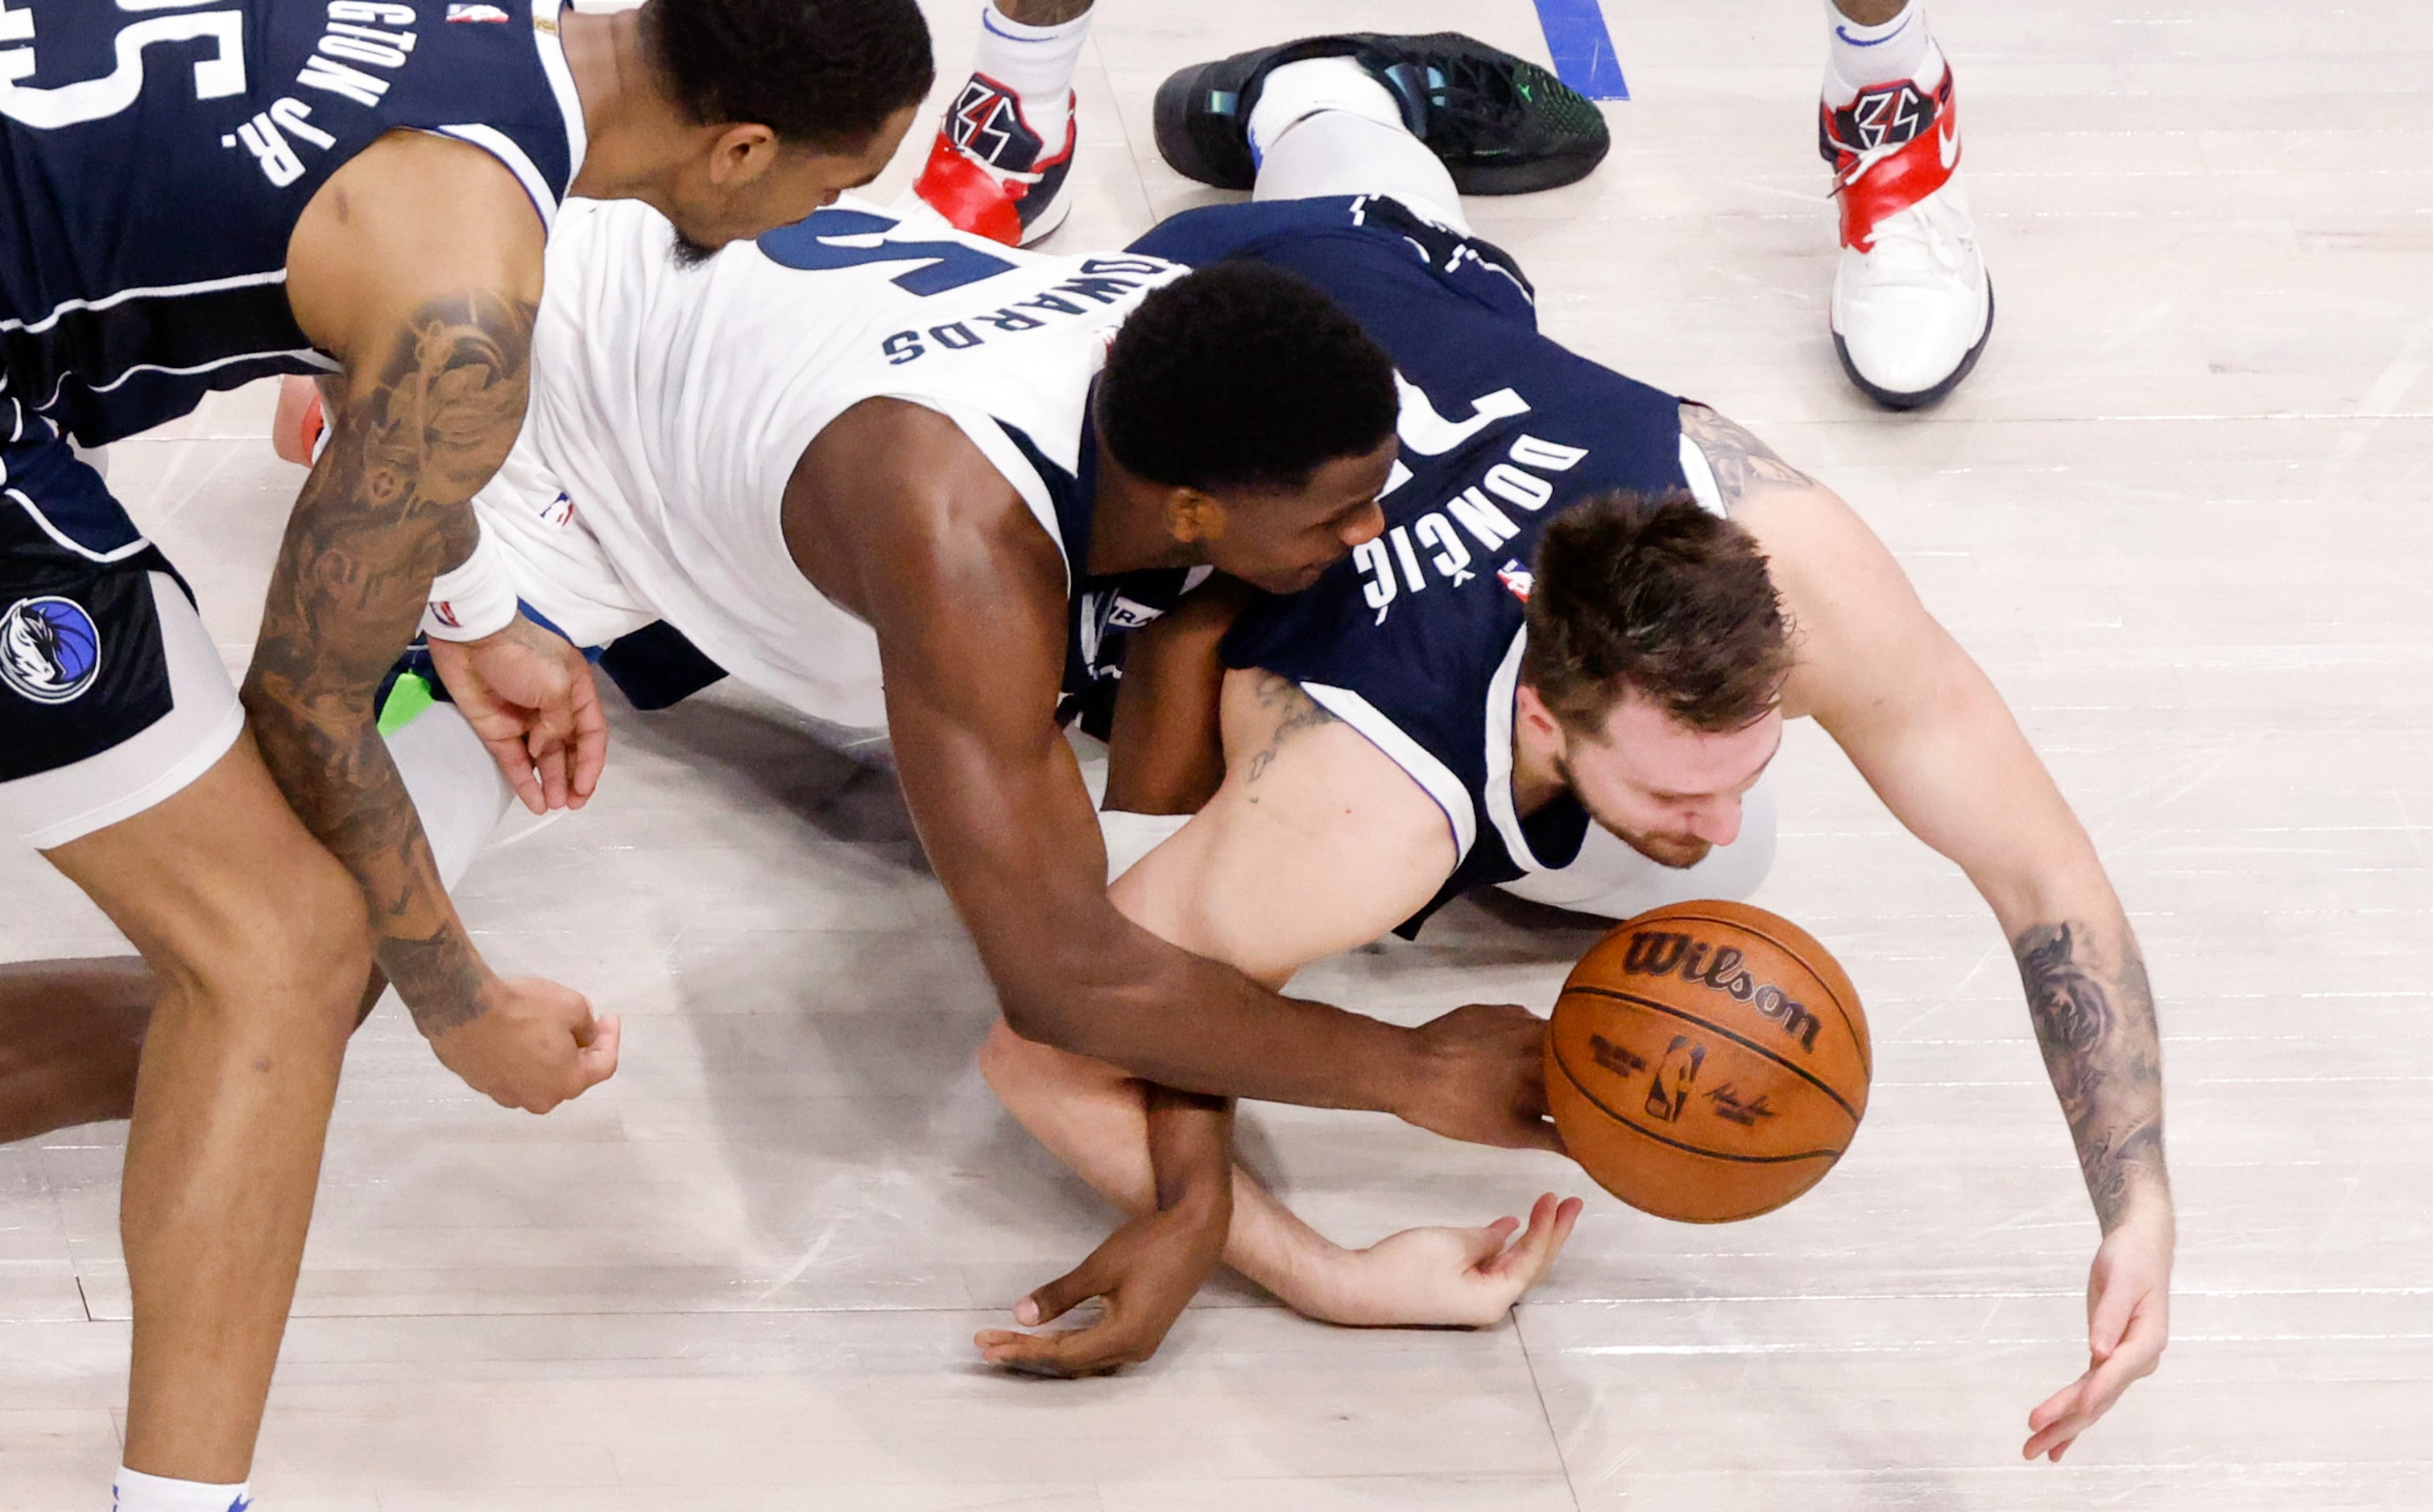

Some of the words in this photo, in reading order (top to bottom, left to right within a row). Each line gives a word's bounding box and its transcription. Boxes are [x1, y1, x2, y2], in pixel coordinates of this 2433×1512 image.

[0, 0, 246, 129] 5
[221, 97, 337, 187] JR.
[755, 208, 1020, 297] 5
[882, 258, 1168, 365] DWARDS
[1352, 433, 1590, 626] DONČIĆ
[1623, 932, 1822, 1054] Wilson
